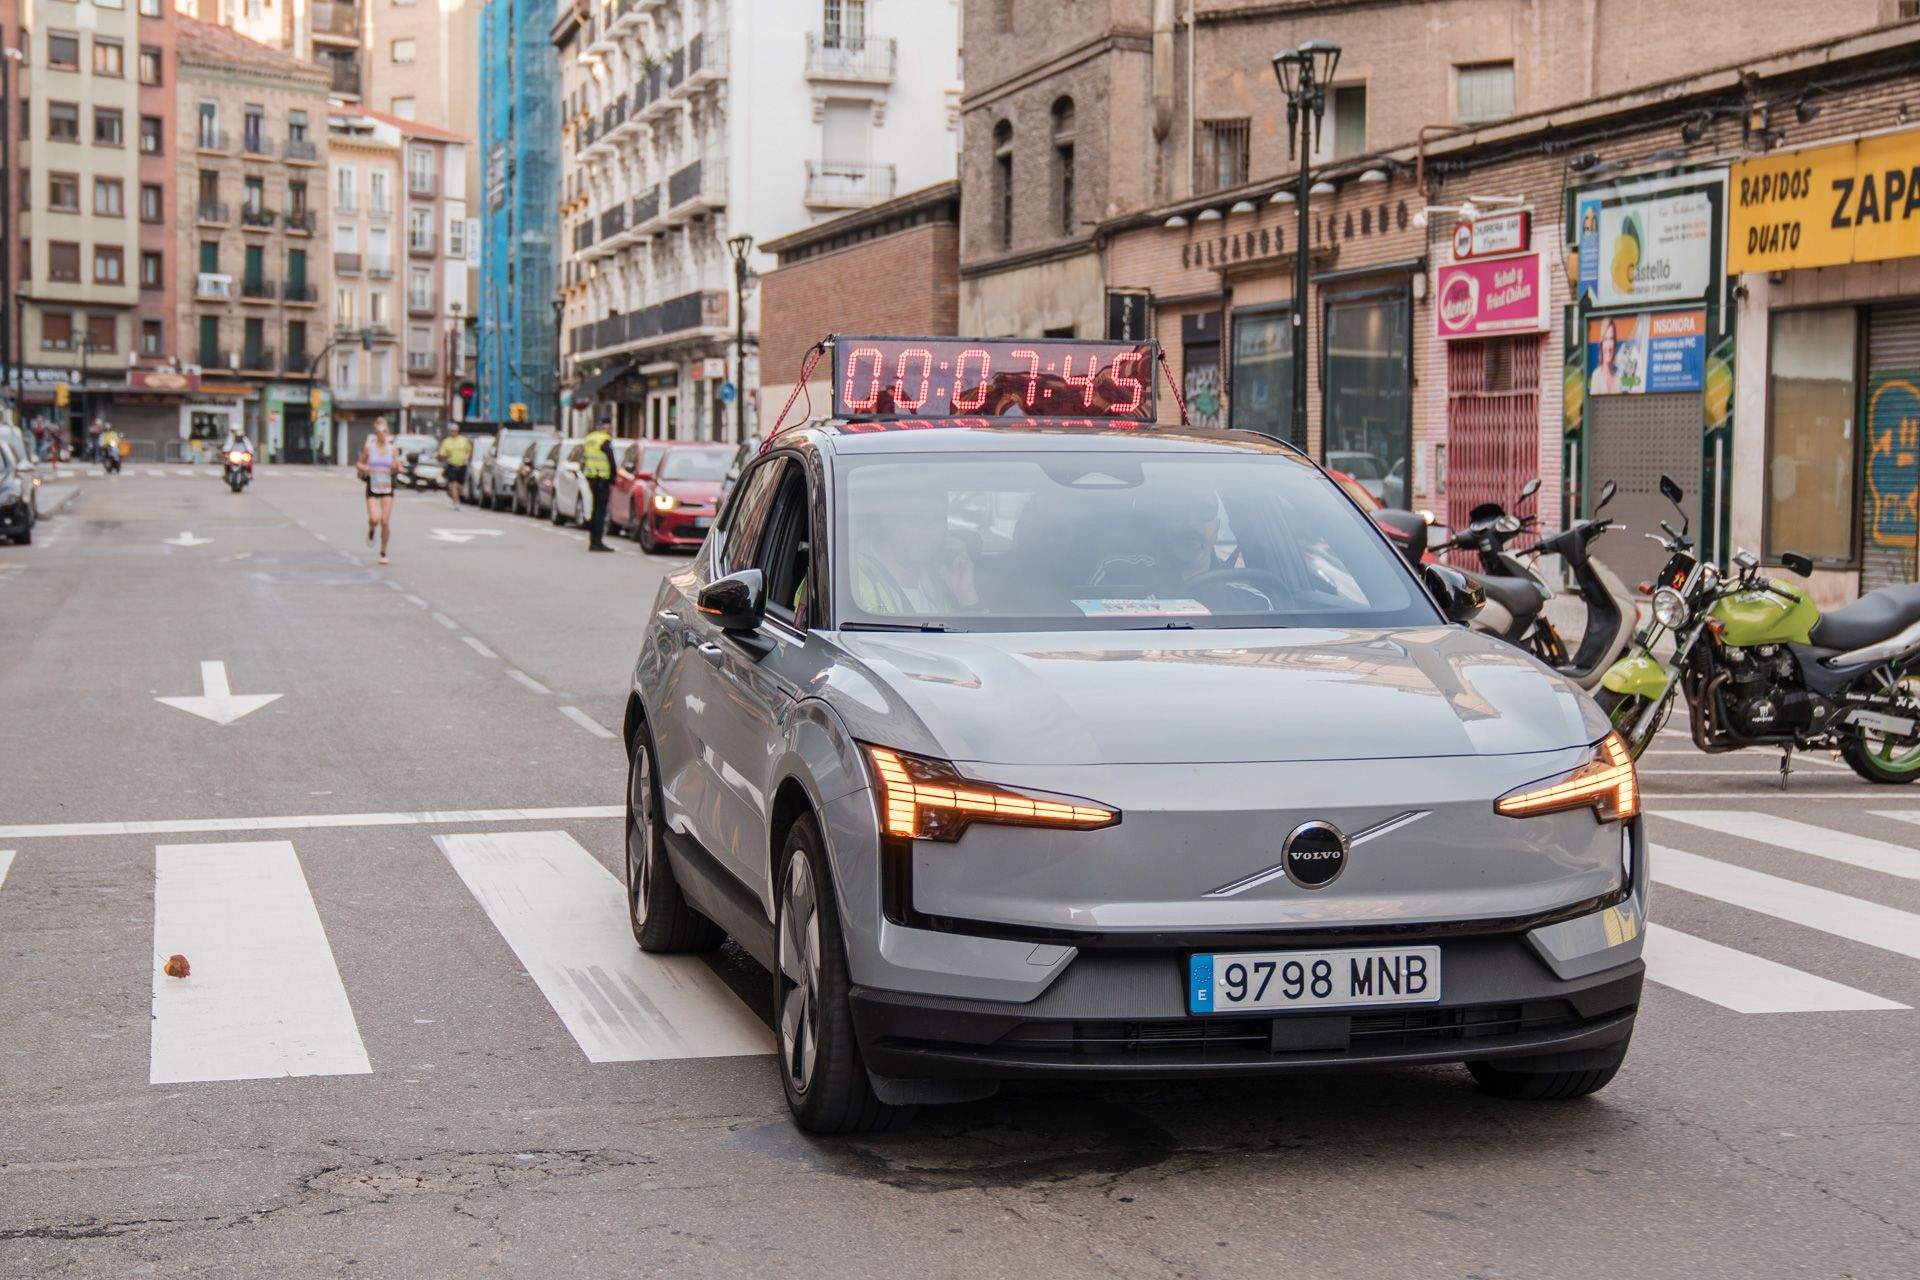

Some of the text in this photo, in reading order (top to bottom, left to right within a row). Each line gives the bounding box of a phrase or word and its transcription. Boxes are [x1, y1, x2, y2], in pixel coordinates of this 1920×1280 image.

[1740, 167, 1812, 207] RAPIDOS
[1831, 166, 1920, 229] ZAPA
[1182, 200, 1408, 269] CALZADOS ICARDO
[1747, 221, 1801, 255] DUATO
[1626, 259, 1671, 284] Castelló
[1653, 317, 1696, 334] INSONORA
[843, 347, 1144, 413] 00:07:45
[1290, 851, 1341, 861] VOLVO
[1198, 955, 1428, 1002] E 9798 MNB
